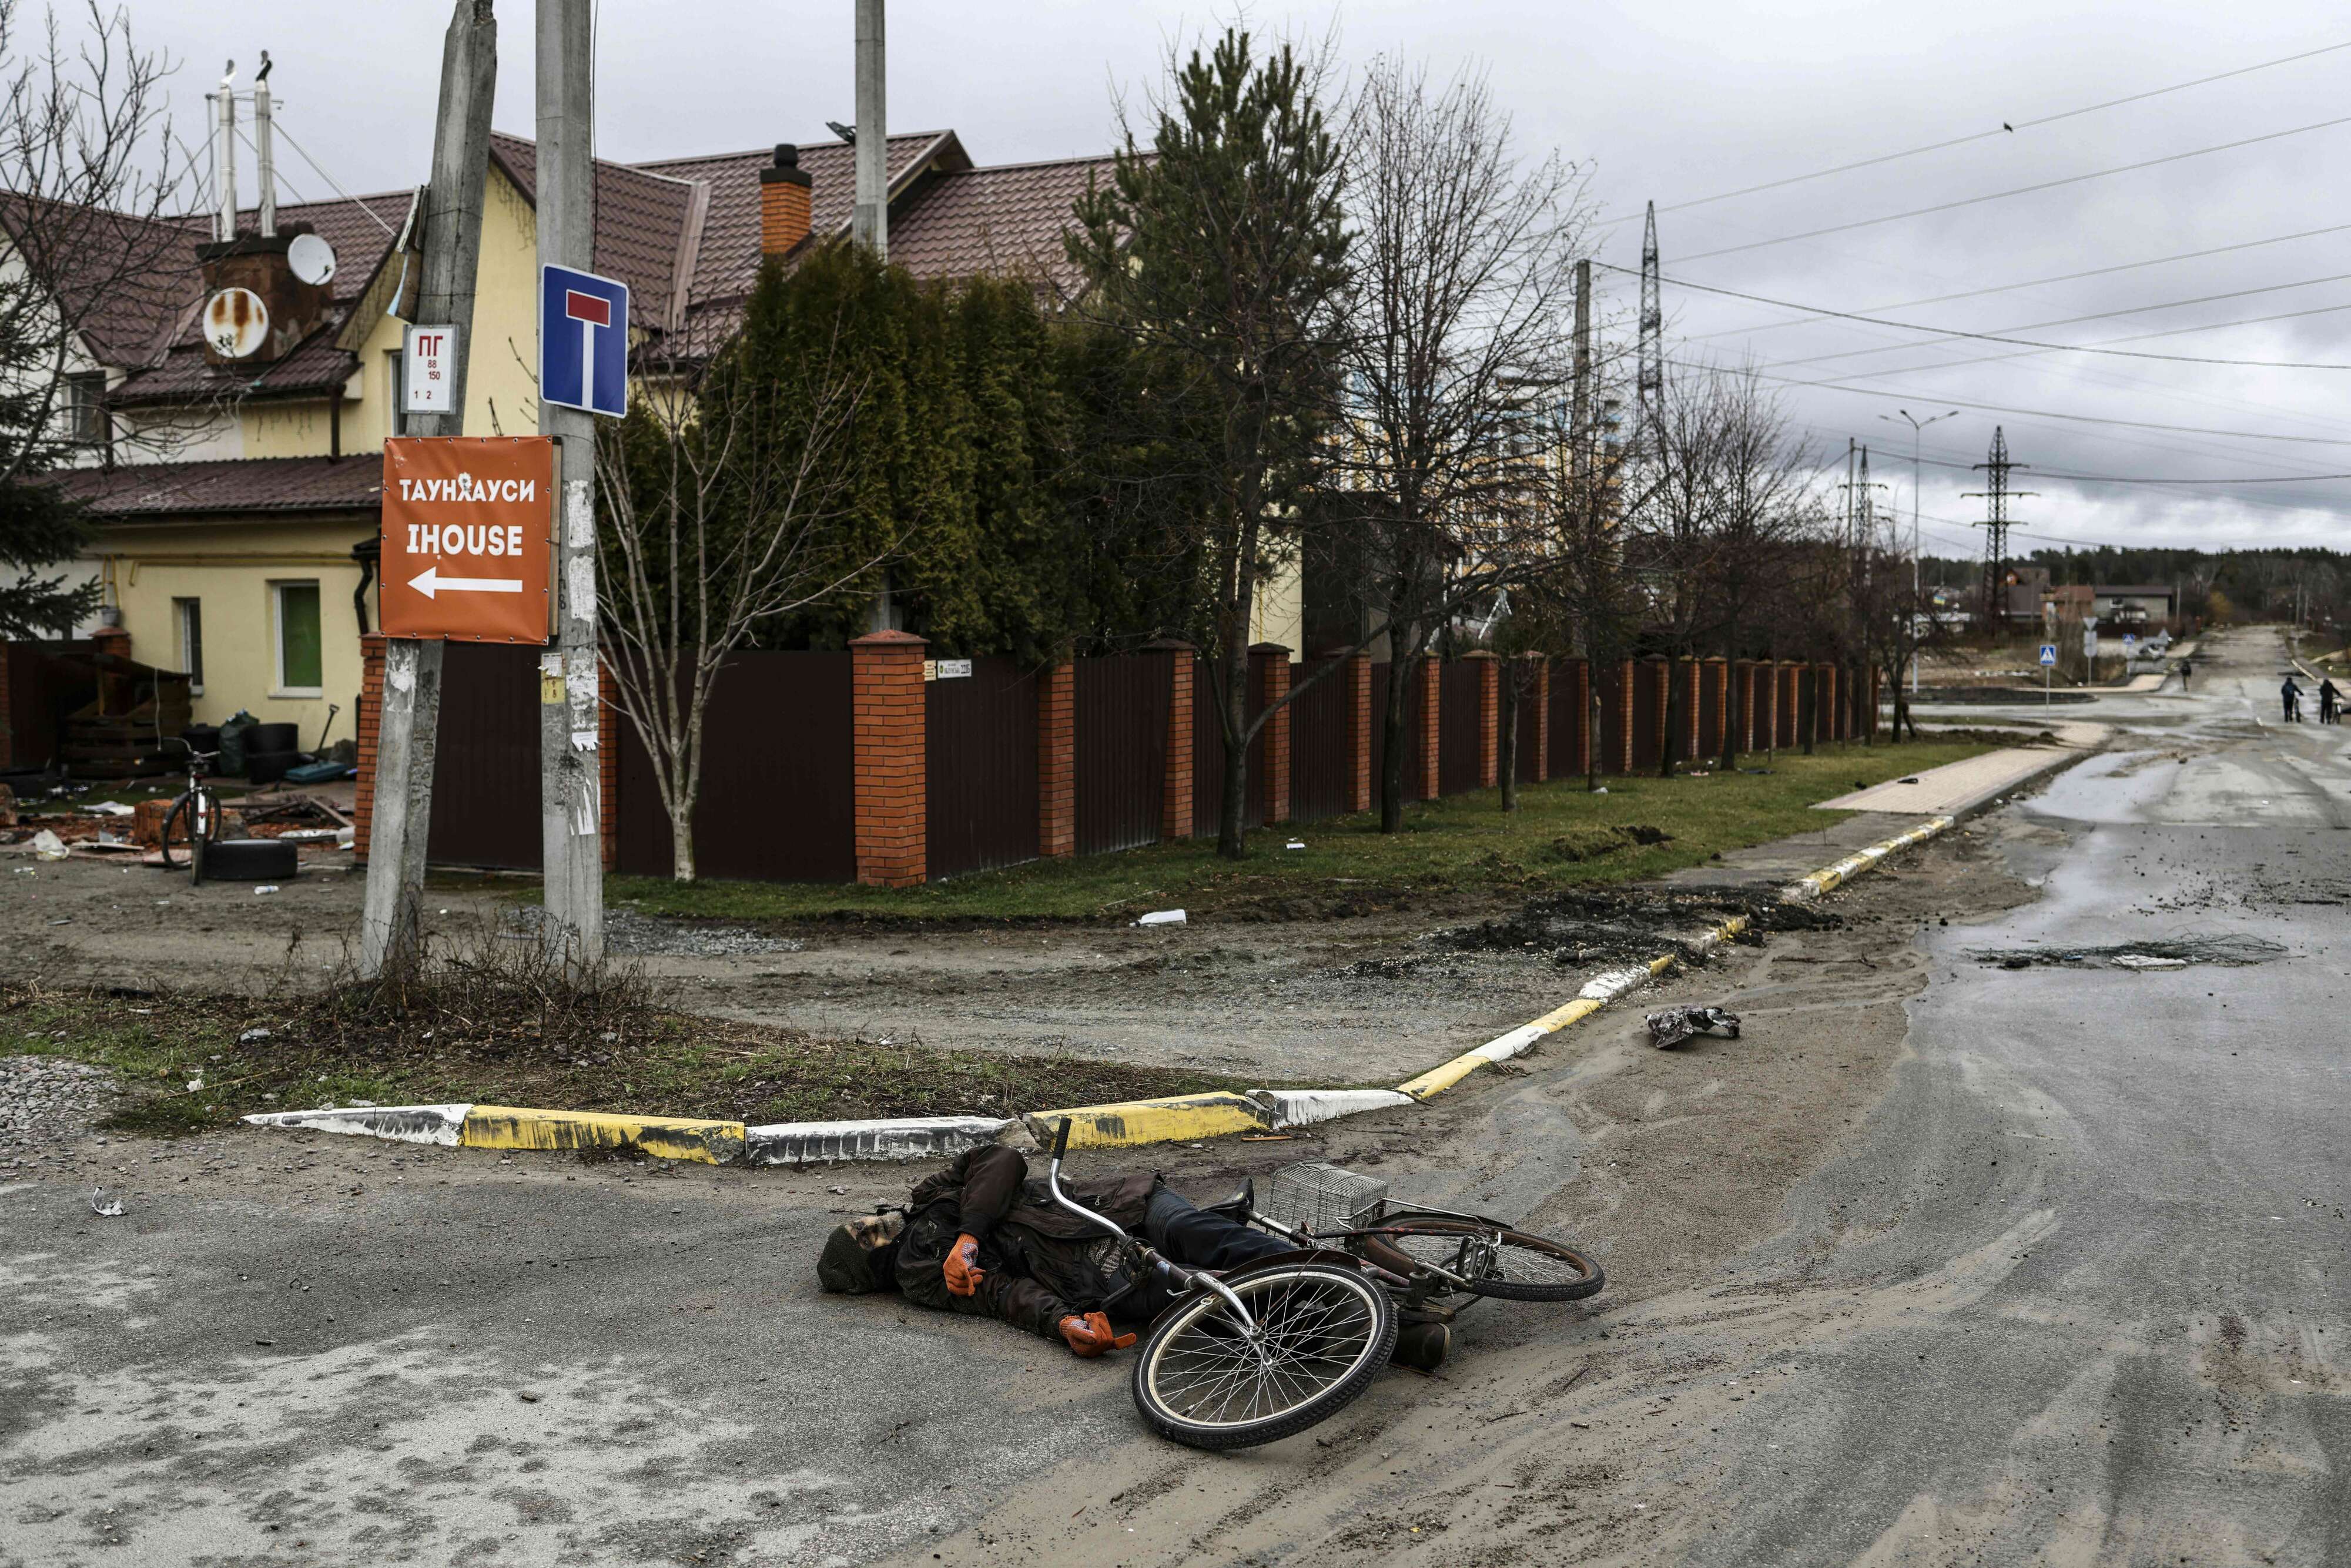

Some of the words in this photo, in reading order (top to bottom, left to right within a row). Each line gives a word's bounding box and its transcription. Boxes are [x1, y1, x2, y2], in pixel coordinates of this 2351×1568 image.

[418, 336, 443, 356] ПГ
[427, 359, 437, 368] 88
[428, 371, 441, 380] 150
[414, 390, 418, 399] 1
[426, 390, 432, 400] 2
[406, 524, 523, 556] IHOUSE
